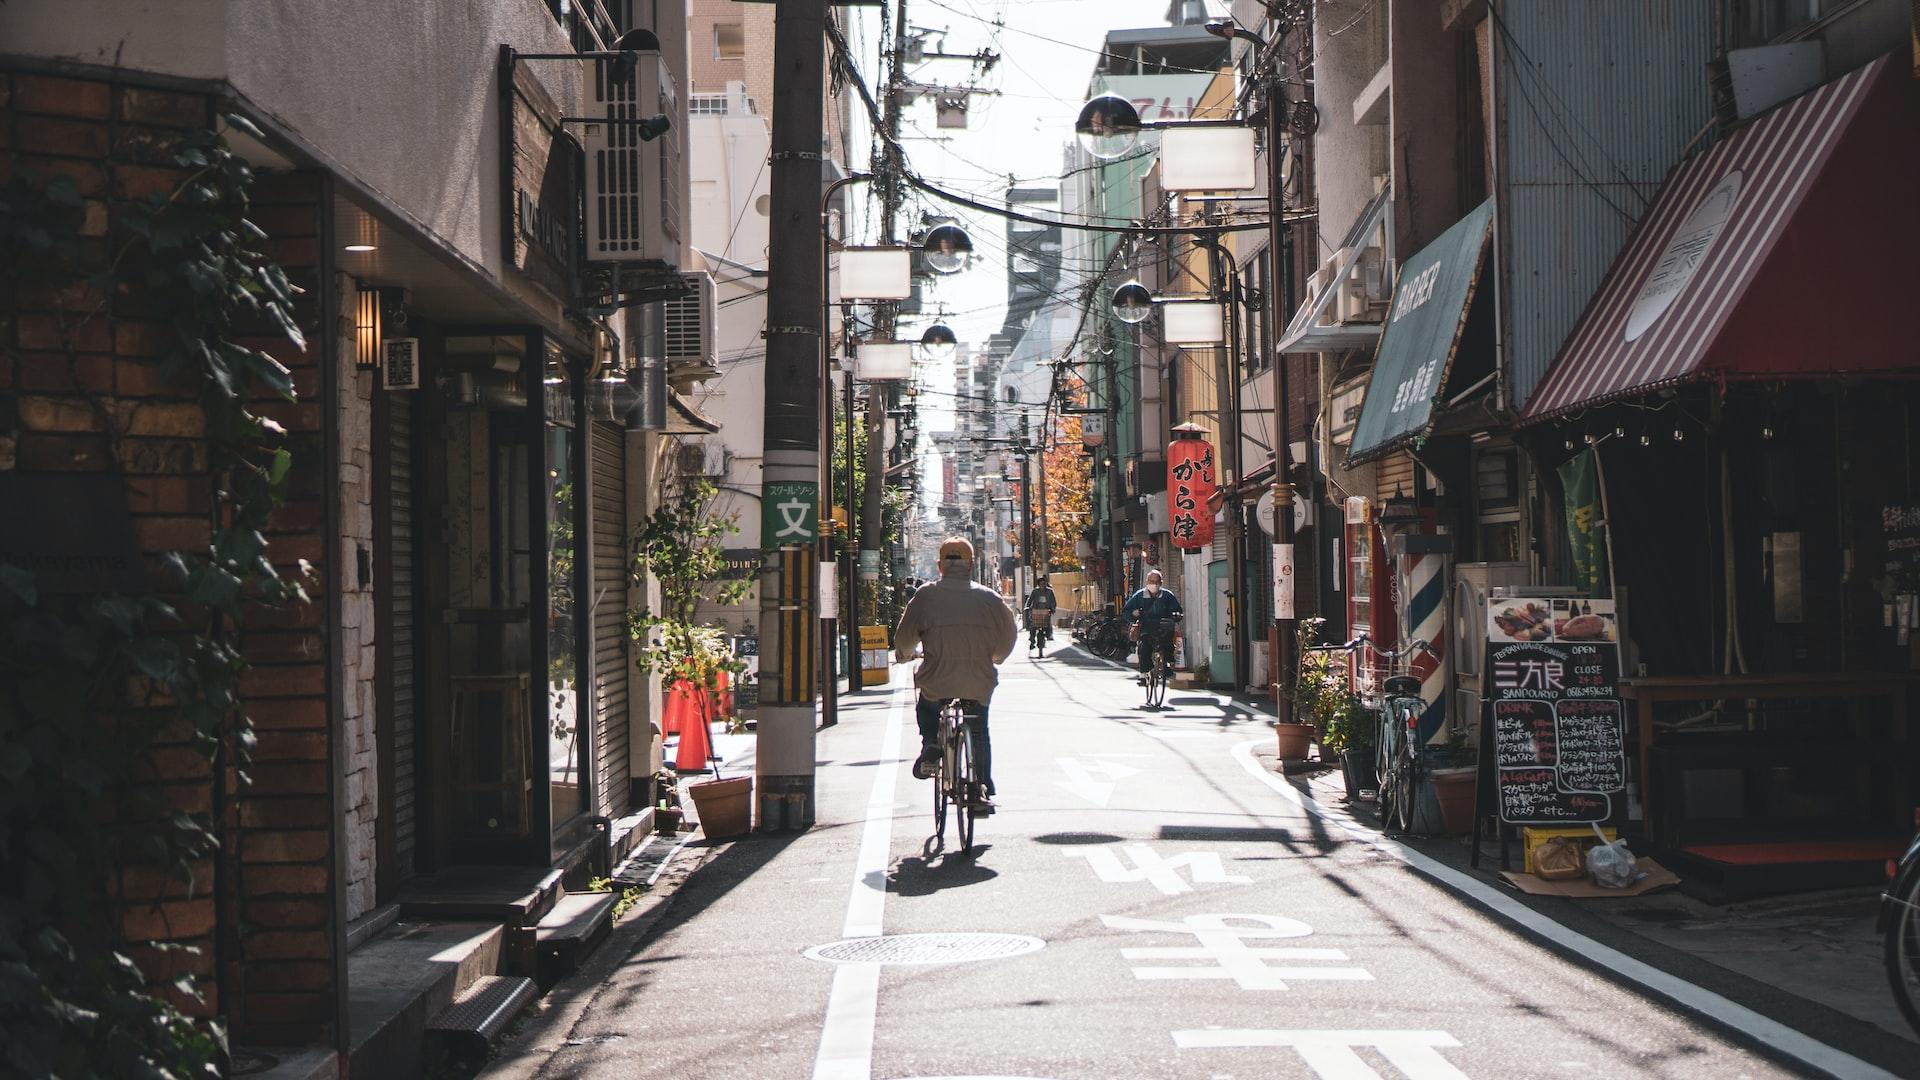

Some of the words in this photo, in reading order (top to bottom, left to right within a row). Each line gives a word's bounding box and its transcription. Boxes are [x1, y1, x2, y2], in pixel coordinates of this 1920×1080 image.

[1393, 261, 1441, 322] BARBER
[1172, 459, 1202, 541] から津
[776, 497, 812, 537] 文
[1572, 646, 1597, 654] OPEN
[1494, 660, 1566, 690] 三方良
[1574, 665, 1602, 674] CLOSE
[1498, 703, 1534, 714] DRINK
[1505, 806, 1536, 816] パスタ
